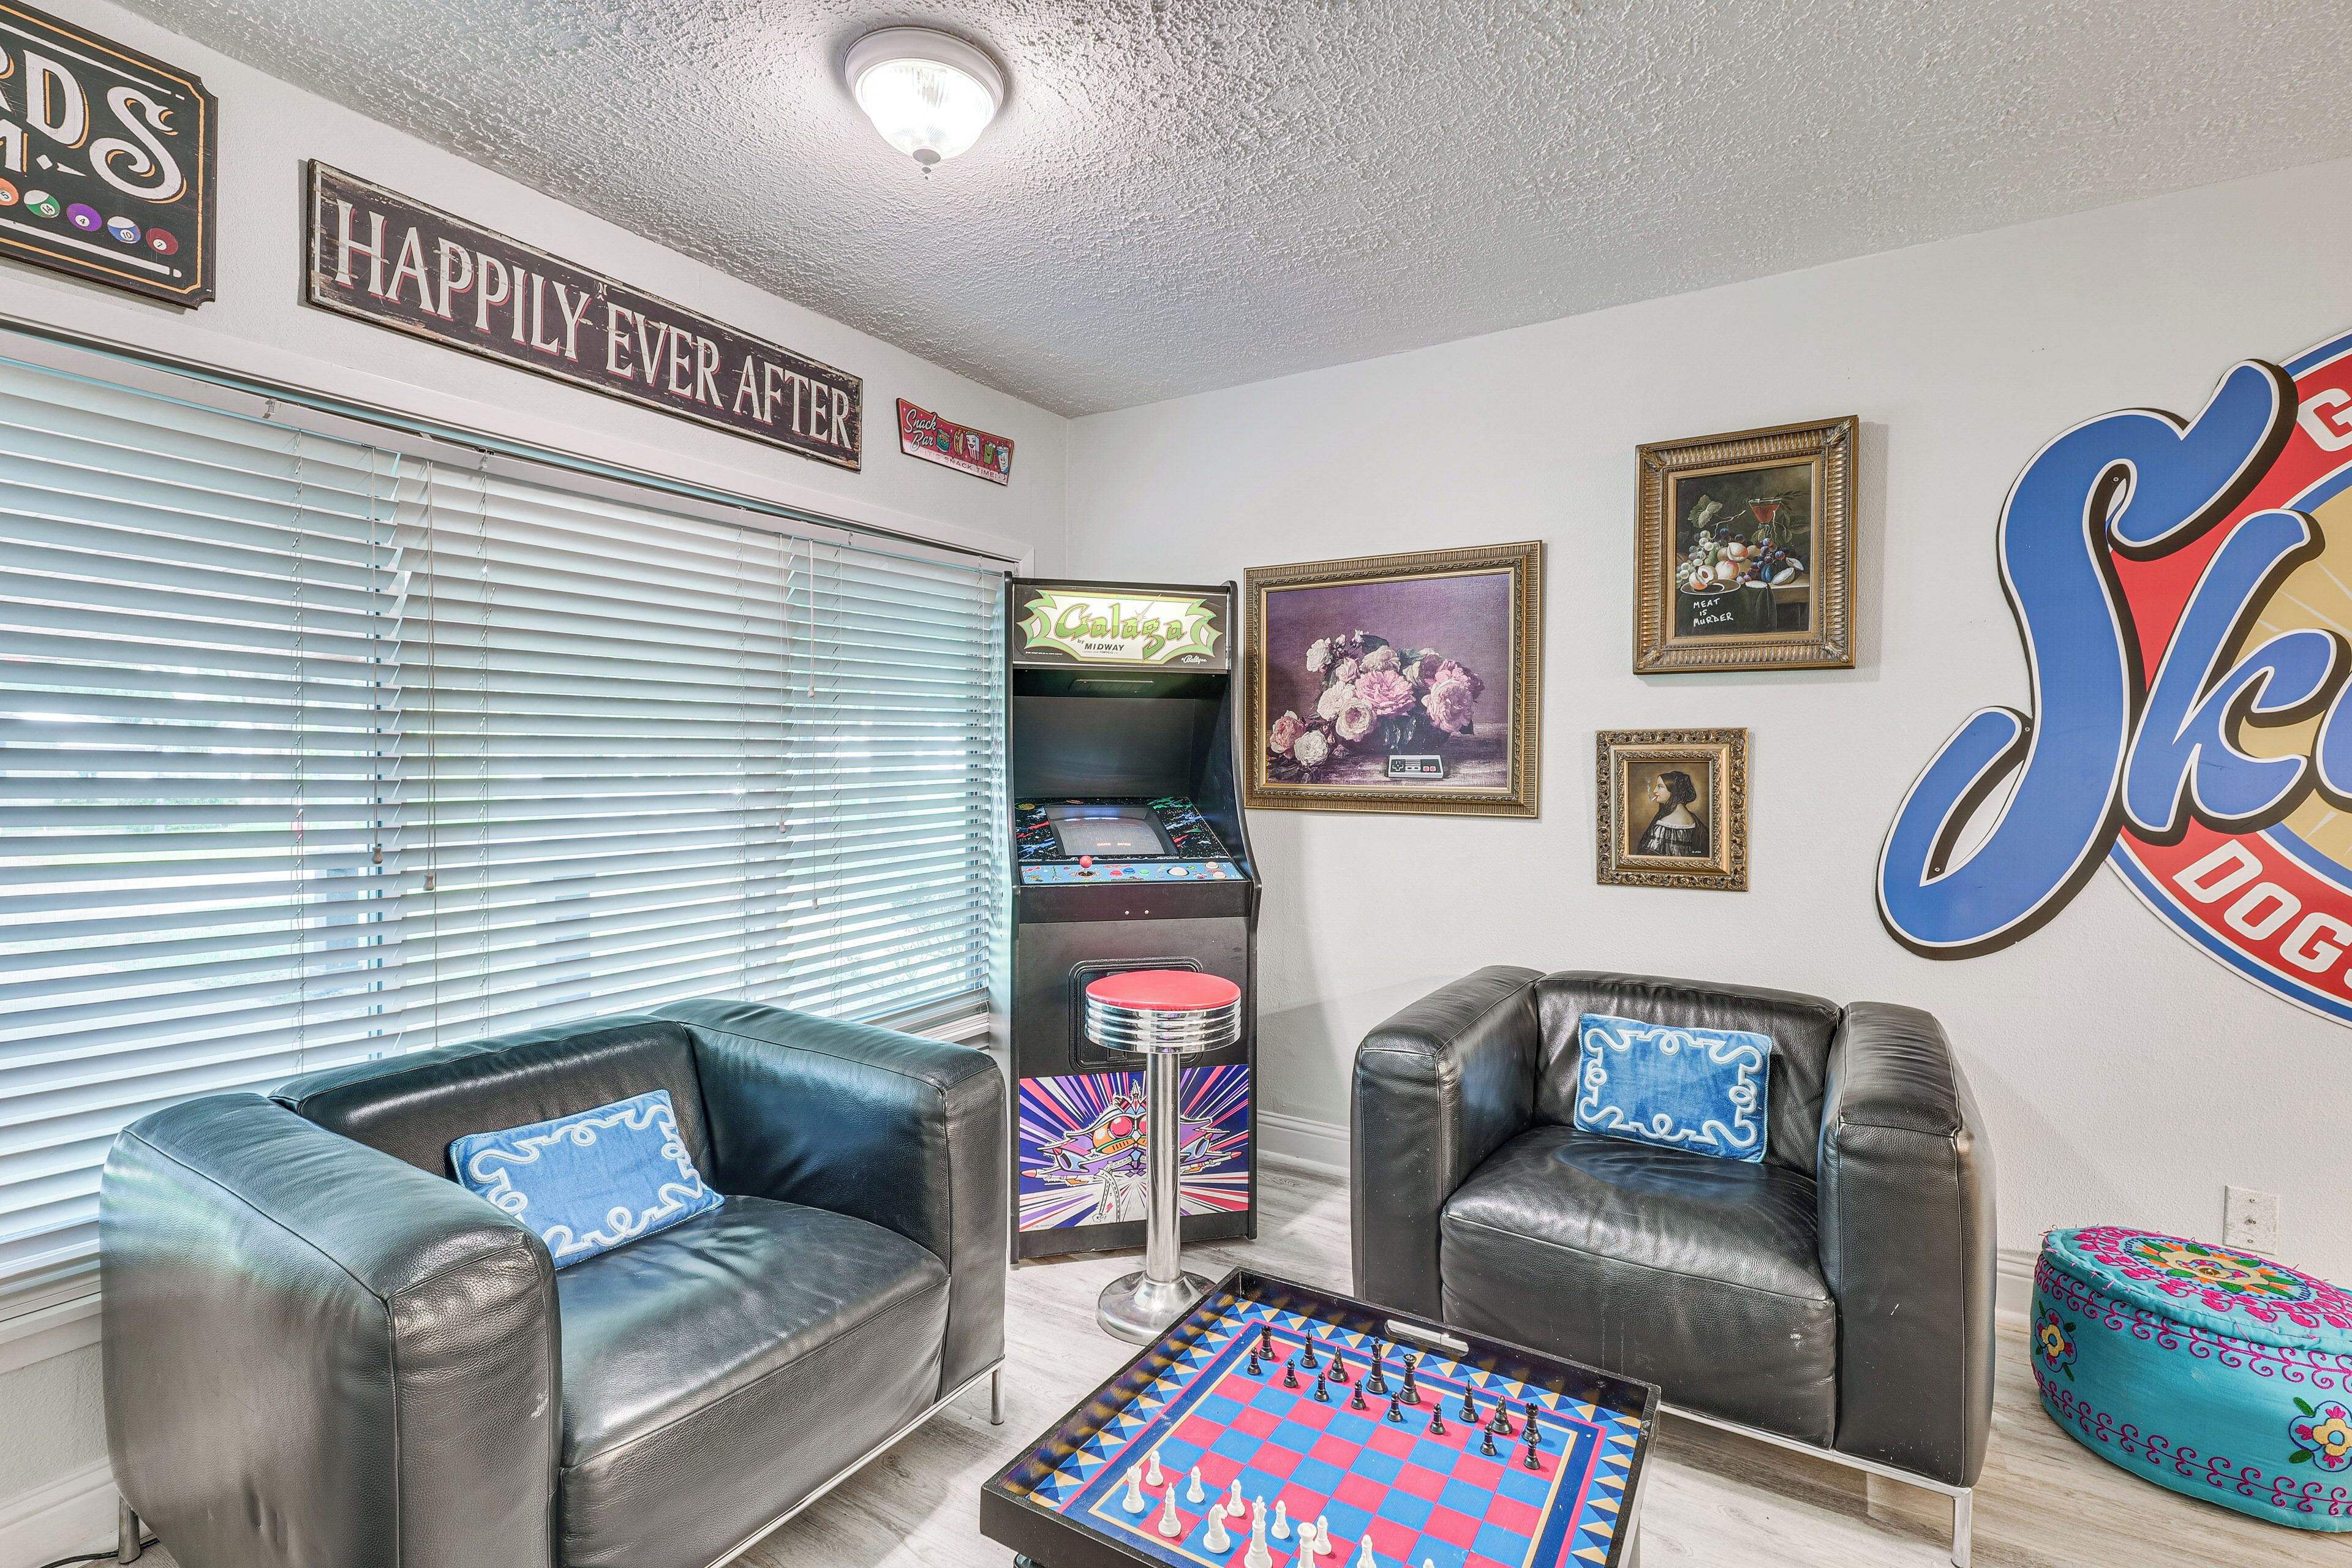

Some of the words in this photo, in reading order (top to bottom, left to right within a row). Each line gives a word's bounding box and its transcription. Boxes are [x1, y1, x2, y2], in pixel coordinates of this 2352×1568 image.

[42, 205, 53, 213] 14
[334, 199, 592, 361] HAPPILY
[606, 301, 725, 410] EVER
[732, 355, 854, 451] AFTER
[903, 409, 937, 434] Snack
[910, 429, 933, 452] Bar
[924, 450, 940, 459] IT'S
[944, 456, 973, 470] SNACK
[976, 467, 998, 478] TIME!
[1693, 597, 1721, 609] MEAT
[1053, 601, 1188, 662] Galaga
[1875, 358, 2352, 960] Sk
[2172, 839, 2352, 990] DOG
